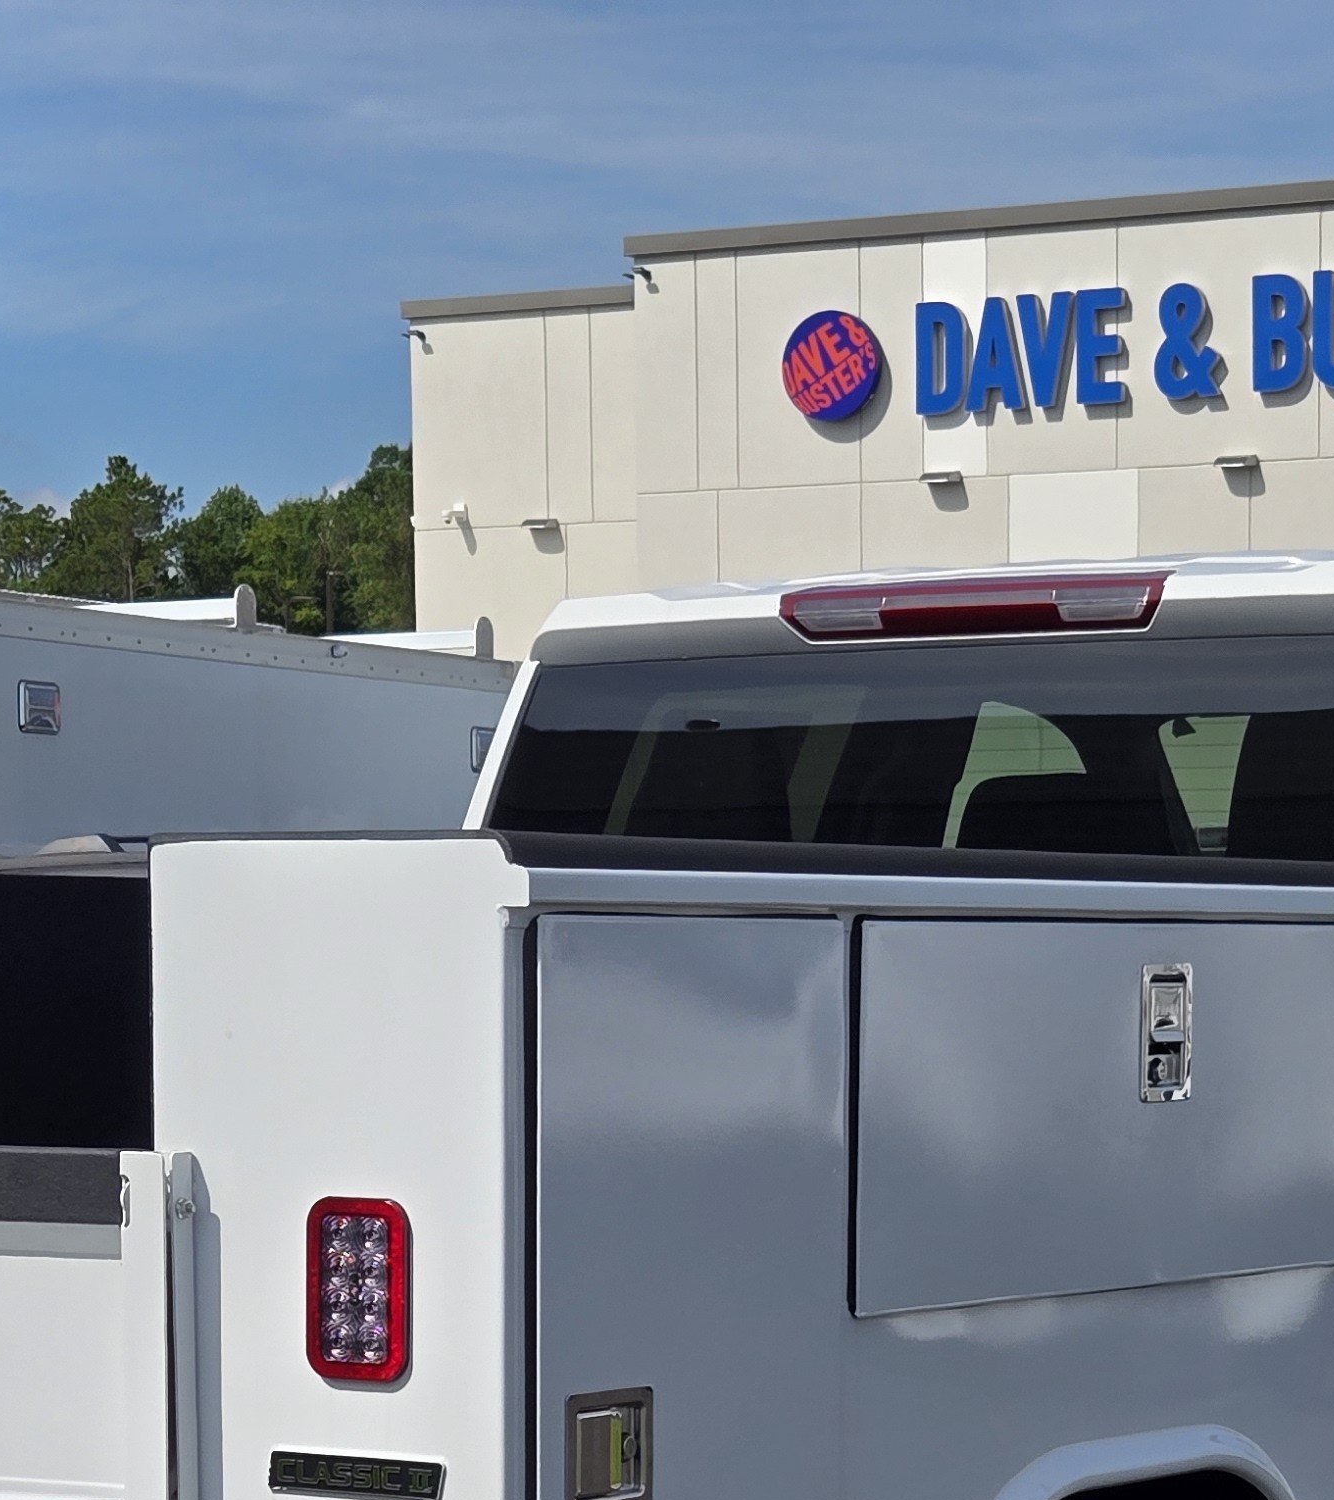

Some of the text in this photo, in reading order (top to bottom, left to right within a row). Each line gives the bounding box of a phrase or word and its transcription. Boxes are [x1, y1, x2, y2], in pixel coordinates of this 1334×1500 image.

[838, 315, 870, 347] &
[916, 288, 1127, 416] DAVE
[1153, 283, 1222, 401] &
[276, 1458, 402, 1491] CLASSIC
